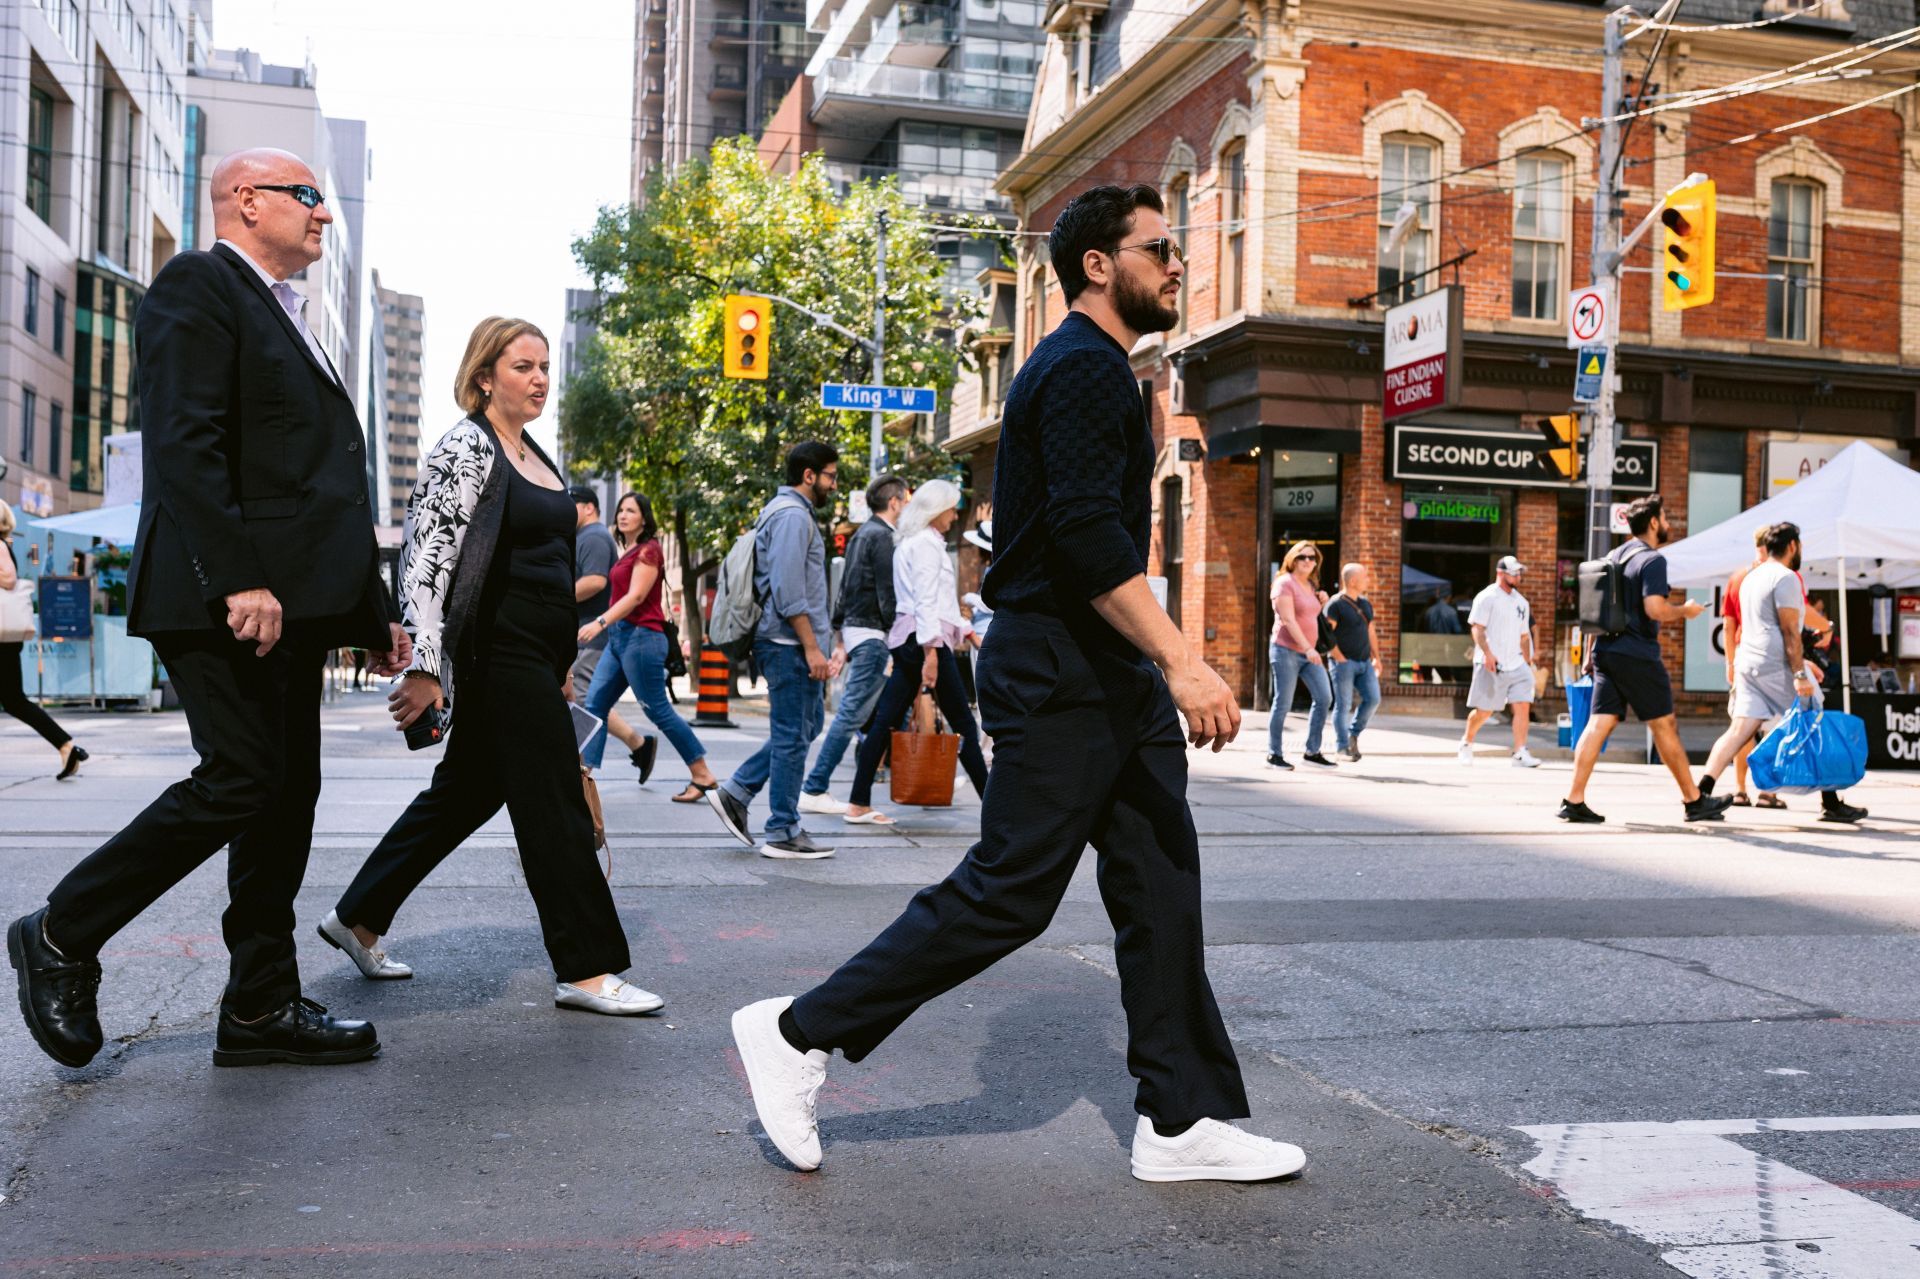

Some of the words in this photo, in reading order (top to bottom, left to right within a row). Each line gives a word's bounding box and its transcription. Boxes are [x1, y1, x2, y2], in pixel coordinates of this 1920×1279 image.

[1389, 310, 1444, 347] AROMA
[1386, 369, 1406, 391] FINE
[1408, 359, 1444, 384] INDIAN
[842, 386, 882, 408] King
[901, 390, 916, 406] W
[1394, 381, 1433, 407] CUISINE
[1407, 444, 1490, 466] SECOND
[1493, 450, 1534, 468] CUP
[1612, 456, 1645, 475] CO.
[1287, 490, 1314, 507] 289
[1419, 499, 1500, 524] pinkberry
